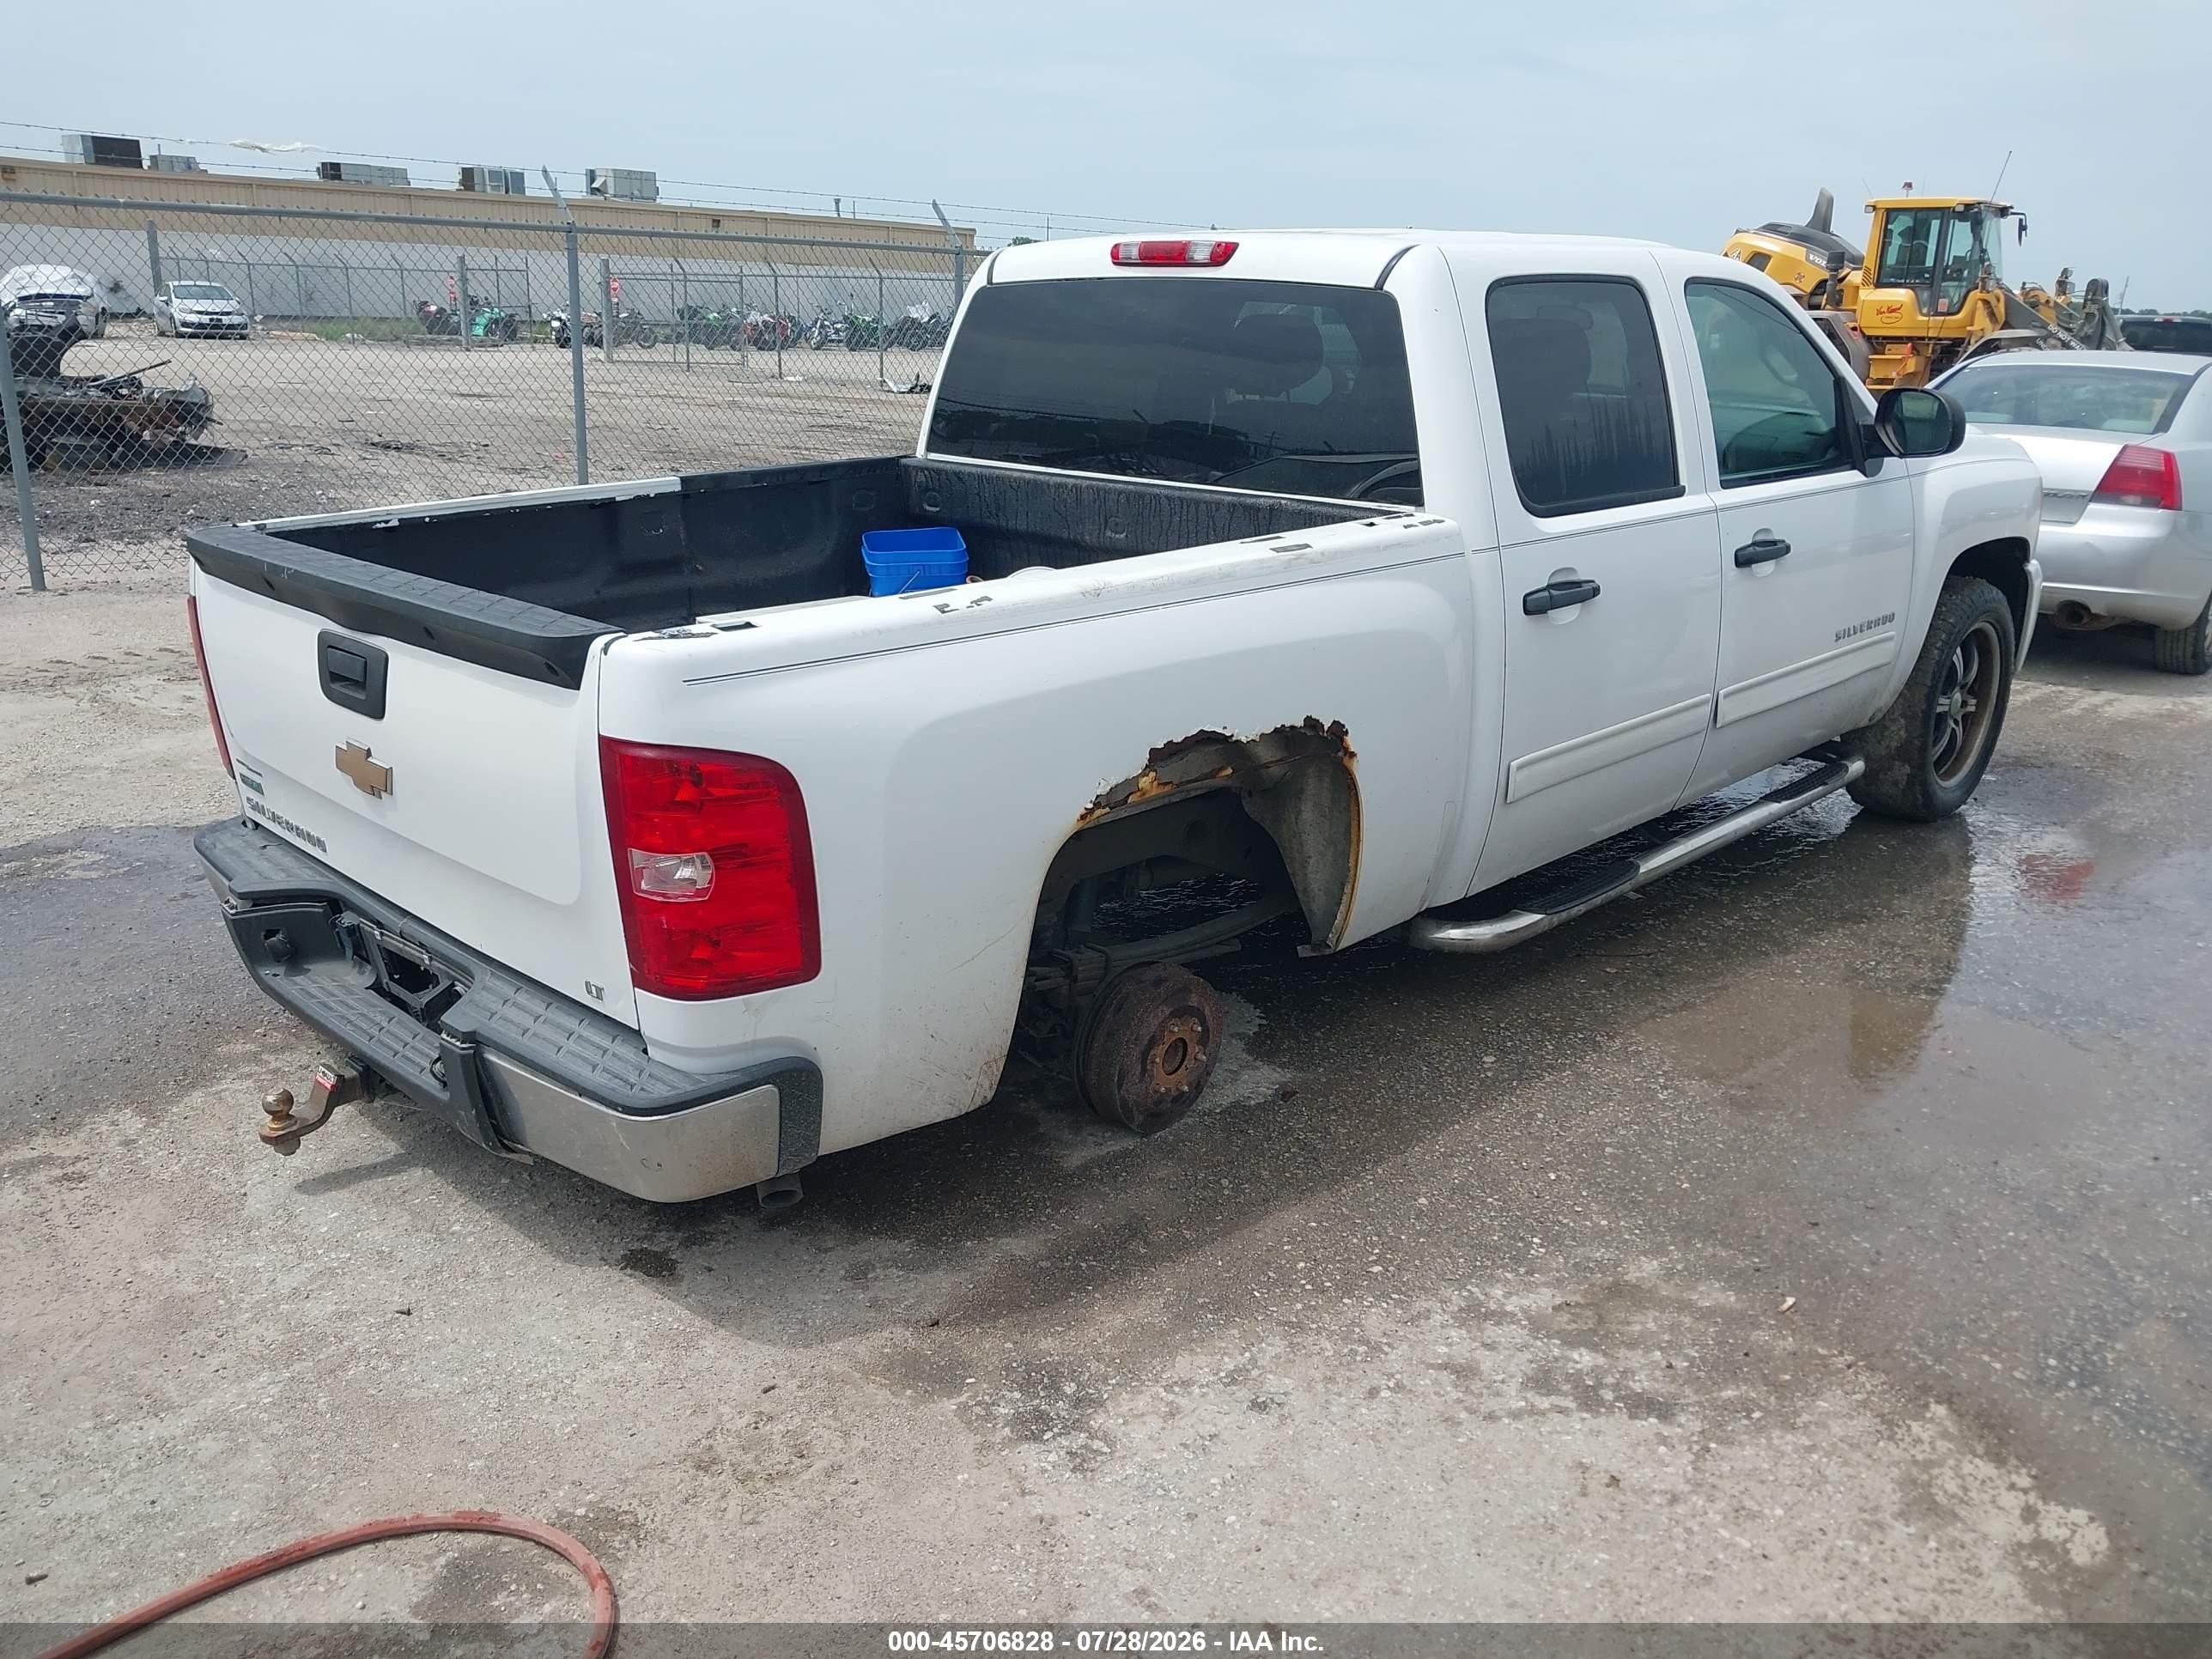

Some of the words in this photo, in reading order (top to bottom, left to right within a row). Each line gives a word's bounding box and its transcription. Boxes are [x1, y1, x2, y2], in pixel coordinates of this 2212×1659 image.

[2047, 324, 2058, 333] DO
[2057, 331, 2071, 343] NOT
[1834, 611, 1895, 642] SILVERADO
[246, 796, 327, 853] SILVERADO
[584, 980, 605, 1001] LT
